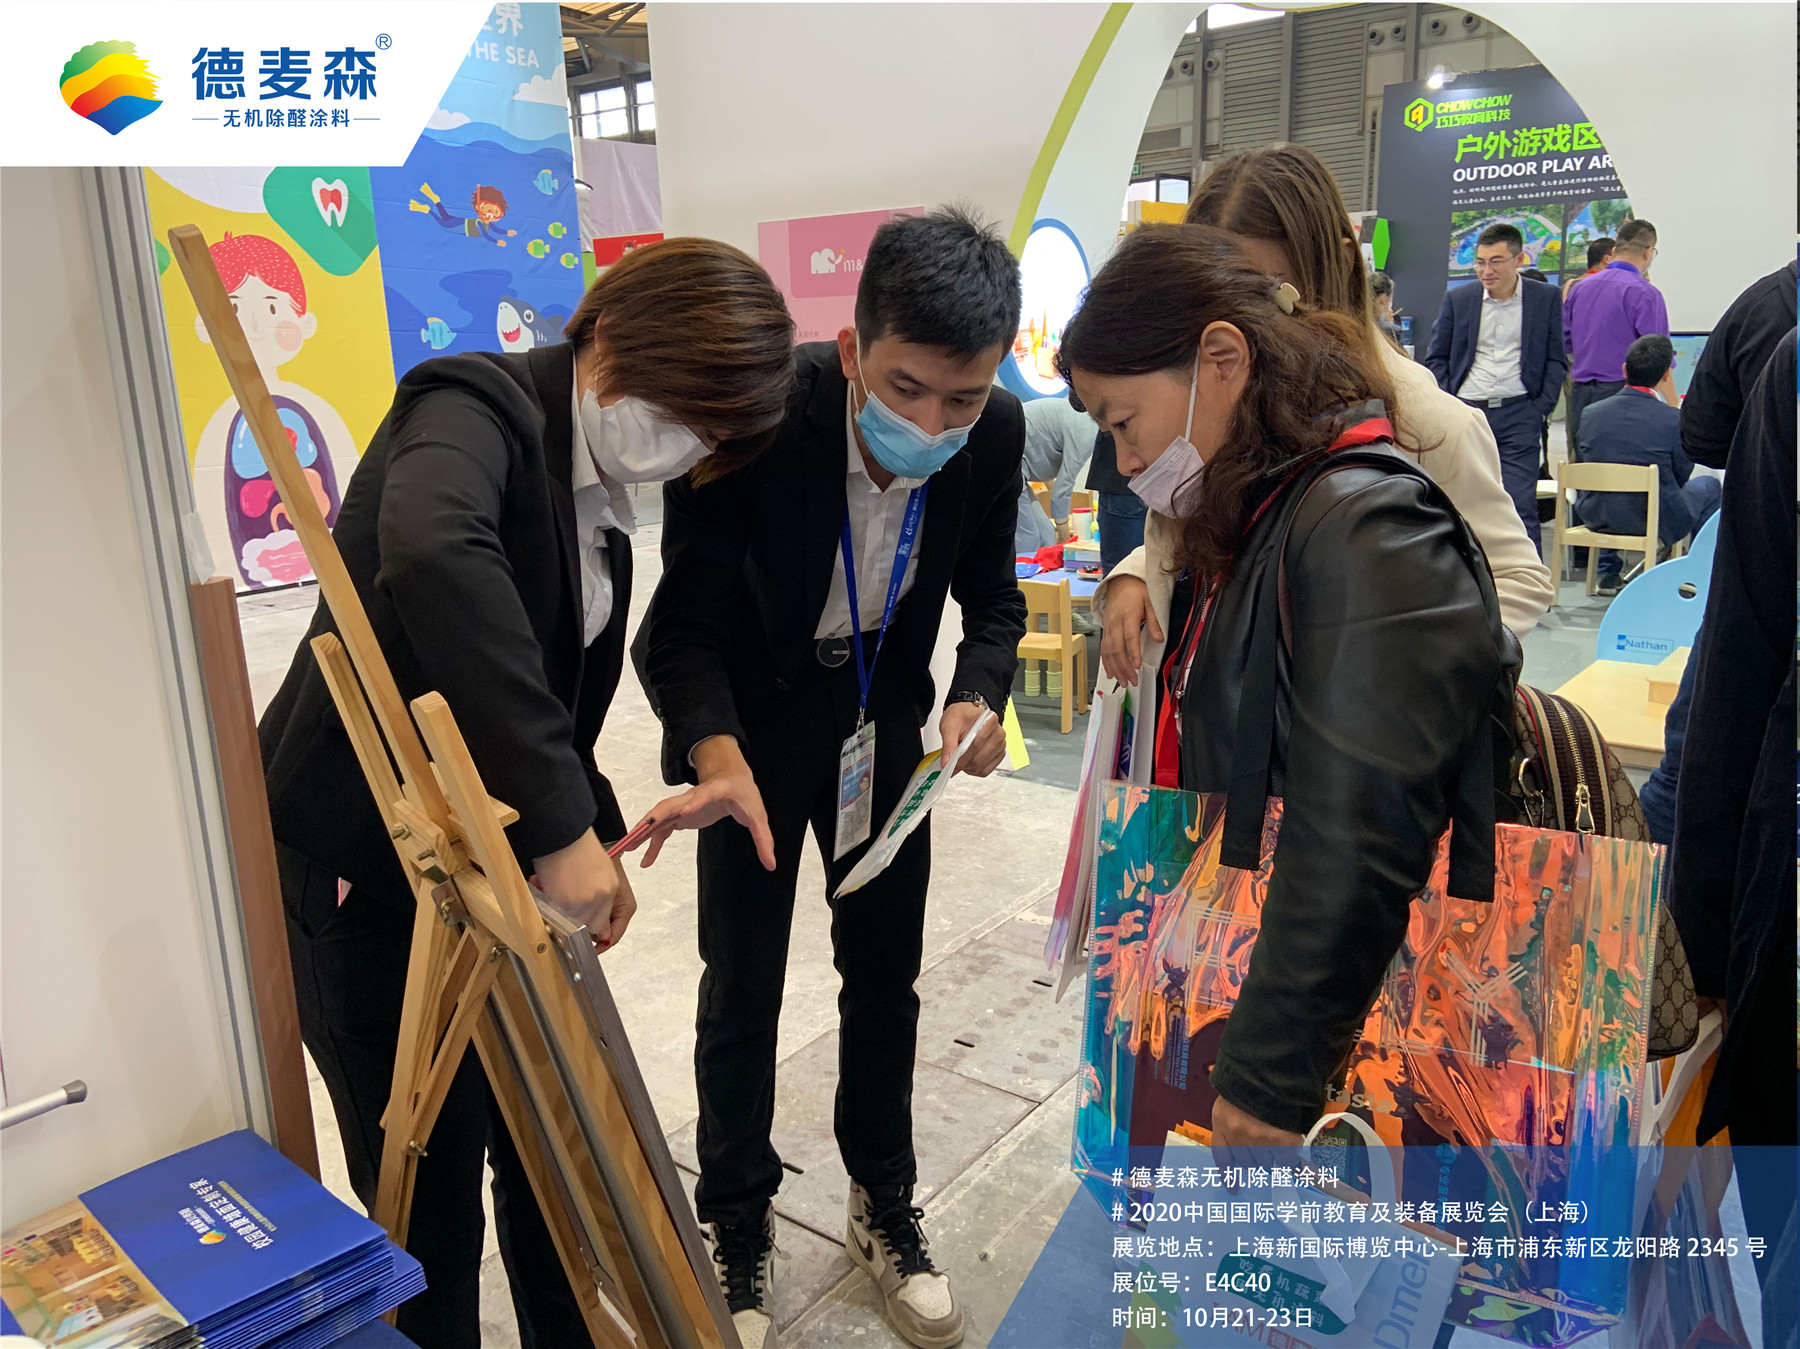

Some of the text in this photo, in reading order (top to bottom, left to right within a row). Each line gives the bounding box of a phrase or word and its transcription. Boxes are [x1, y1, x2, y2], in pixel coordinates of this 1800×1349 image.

[482, 3, 524, 37] 界
[467, 40, 539, 68] HE SEA
[1435, 94, 1512, 114] CHOWCHOW
[1454, 122, 1604, 164] 户外游戏区
[1453, 155, 1613, 182] OUTDOOR PLAY AR
[1626, 639, 1668, 651] Nathan
